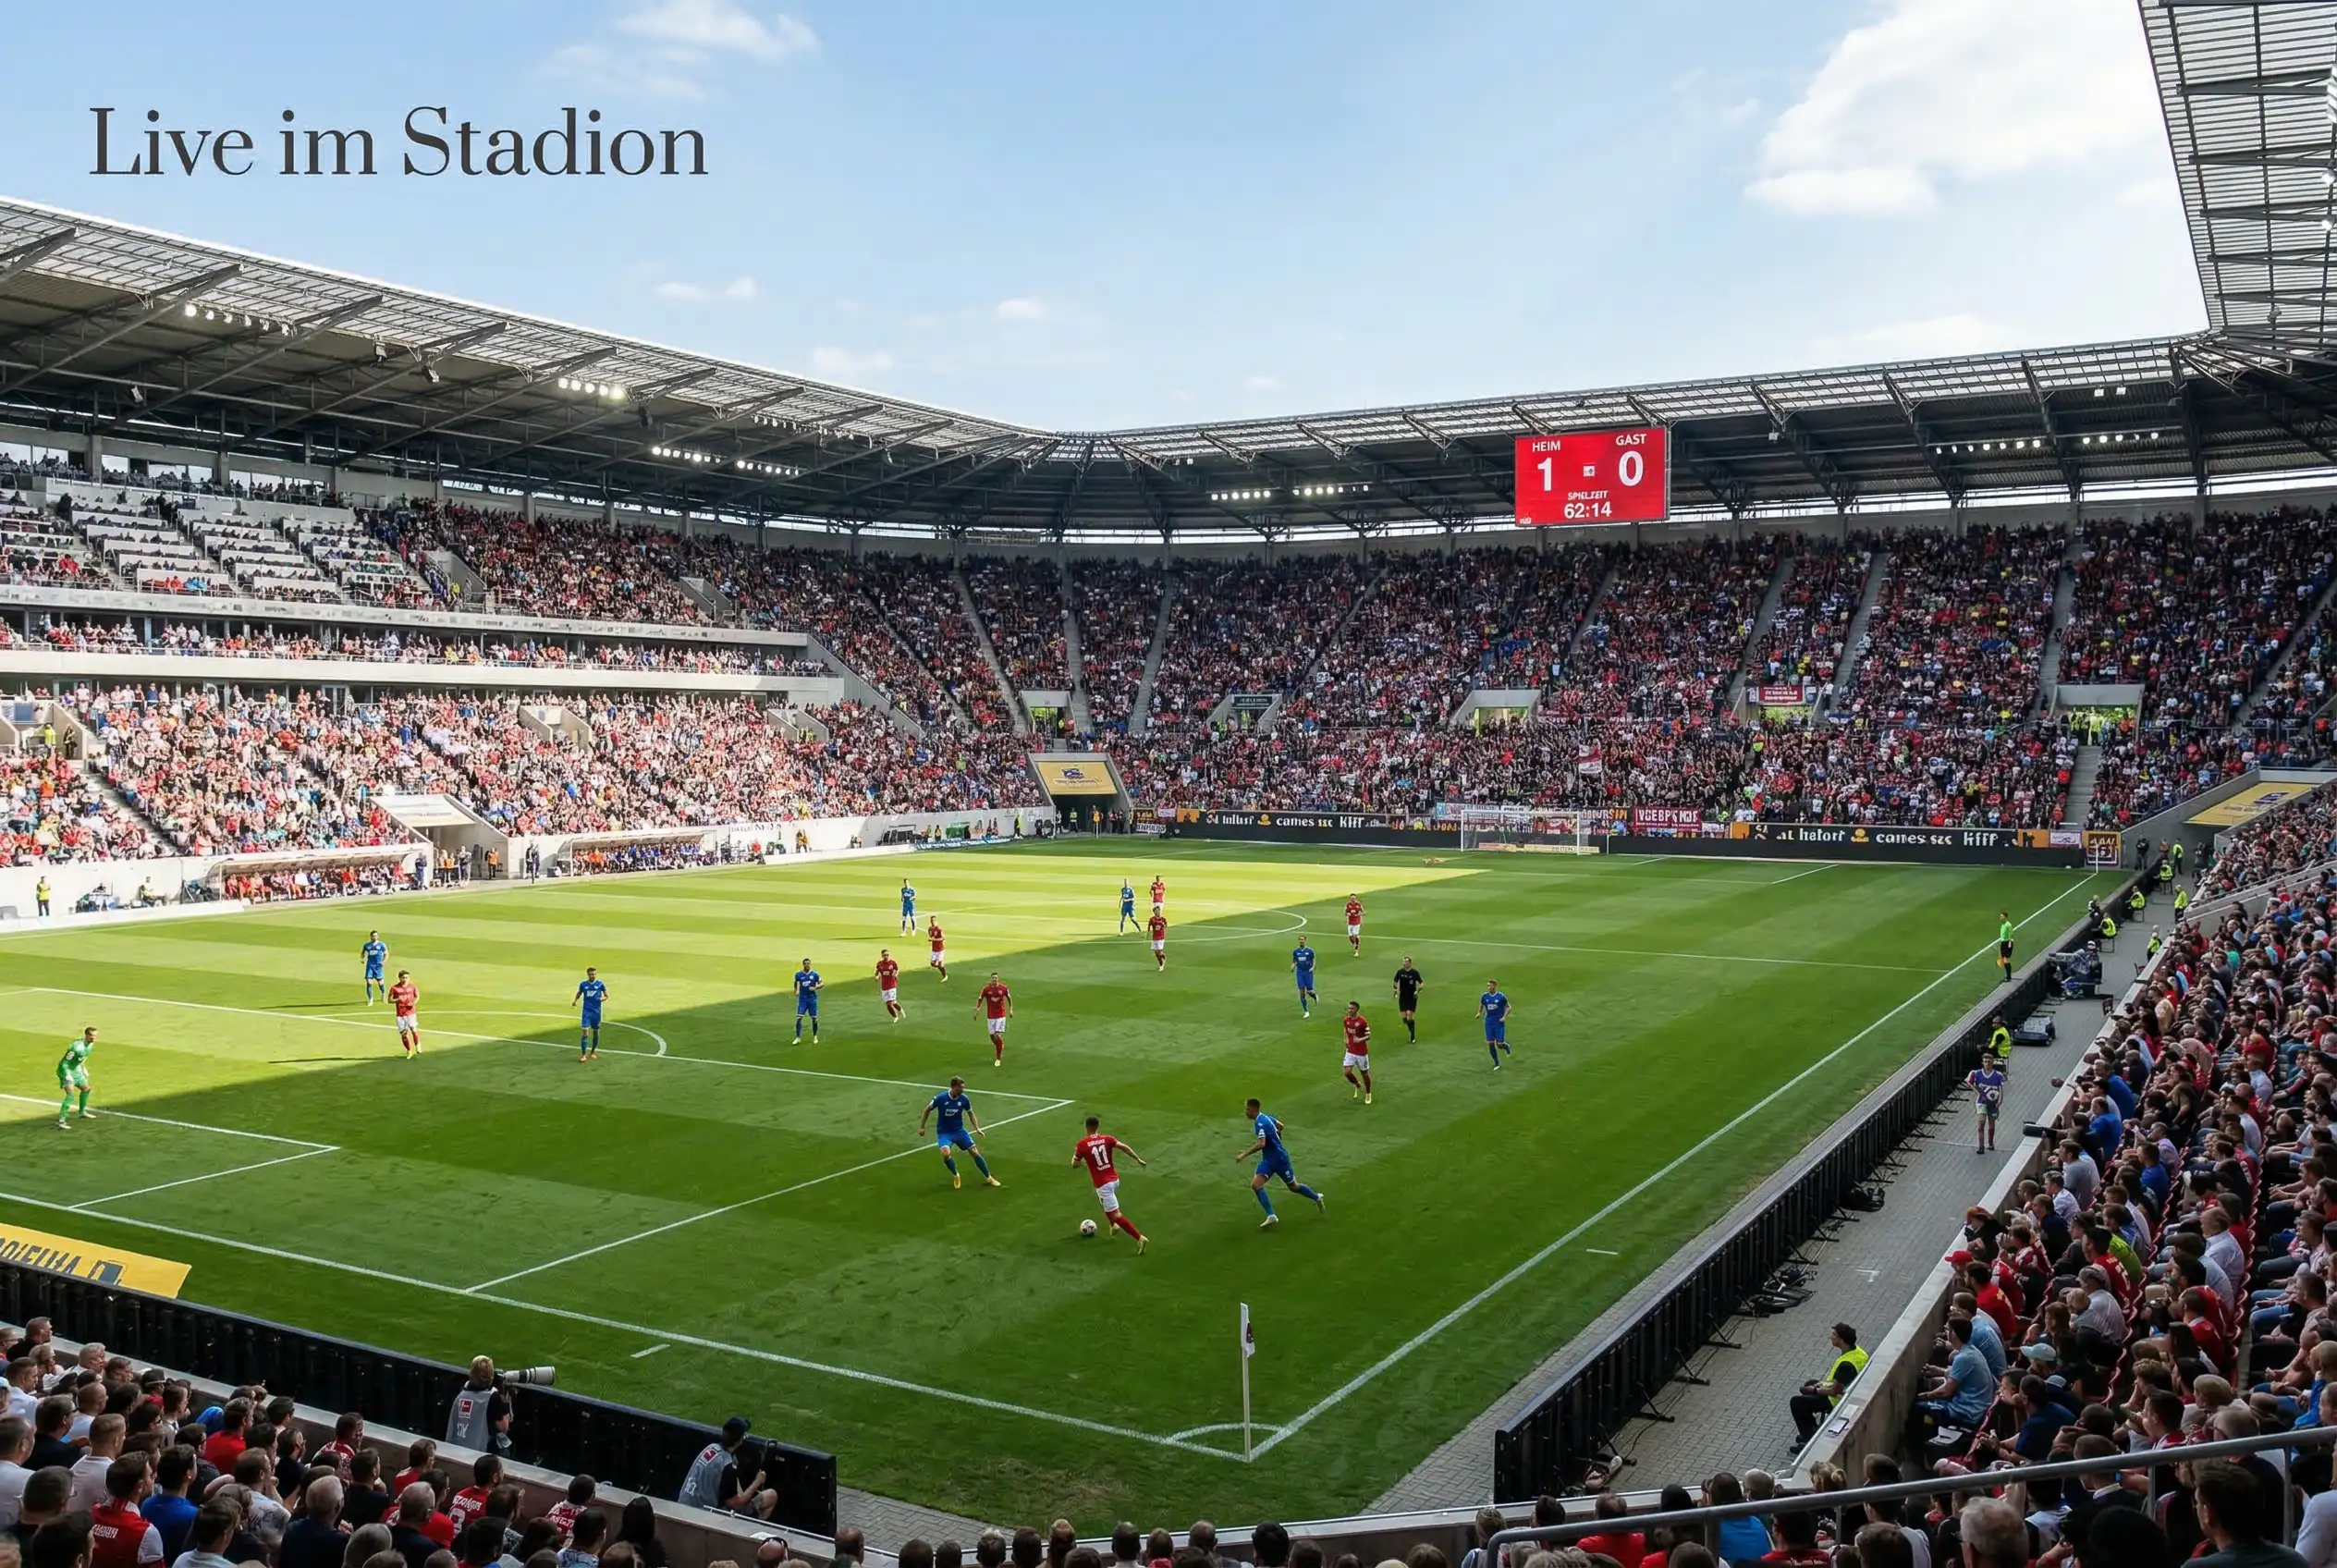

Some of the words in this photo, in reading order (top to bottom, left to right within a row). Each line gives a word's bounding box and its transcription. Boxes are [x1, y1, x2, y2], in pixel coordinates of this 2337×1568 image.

[1532, 440, 1560, 452] HEIM
[1615, 433, 1646, 446] GAST
[1537, 457, 1552, 492] 1
[1619, 450, 1644, 486] 0
[1567, 489, 1609, 501] SPIELZEIT
[1563, 501, 1612, 519] 62:14
